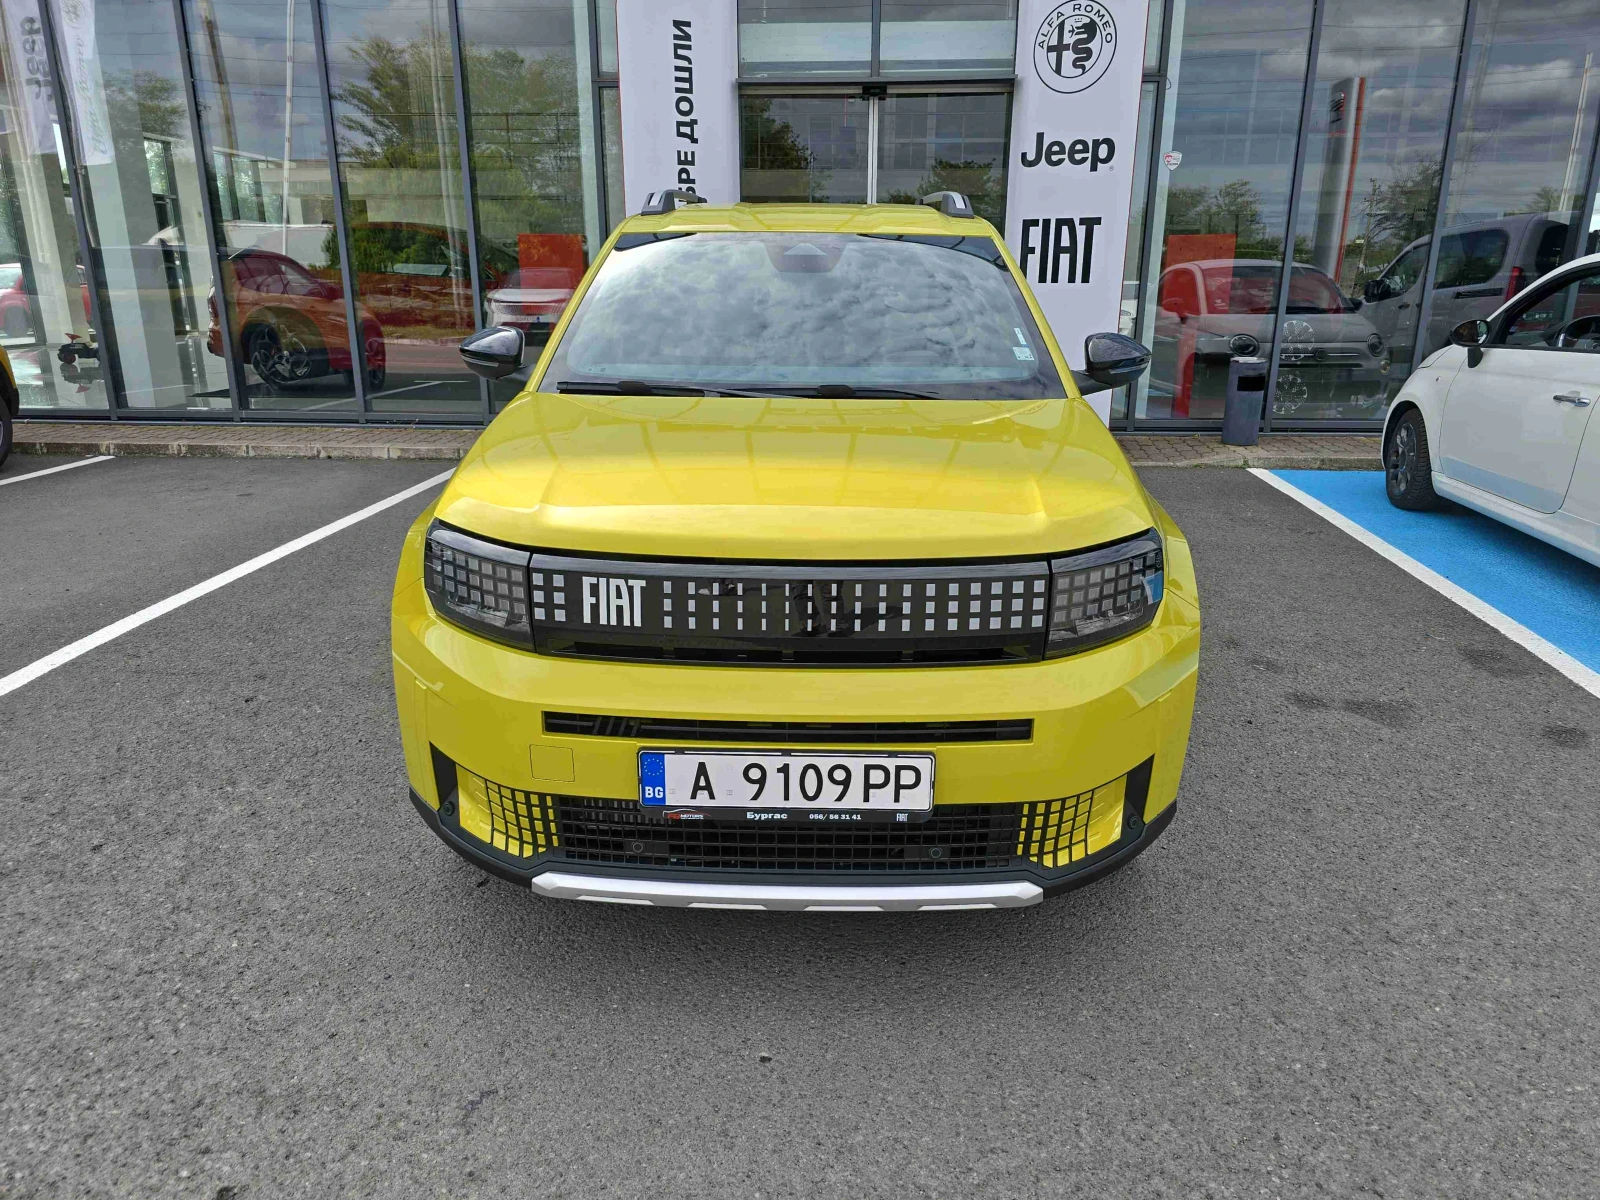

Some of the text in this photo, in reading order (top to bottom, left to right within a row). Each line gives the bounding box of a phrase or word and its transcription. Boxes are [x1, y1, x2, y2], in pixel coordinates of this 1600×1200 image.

[1037, 3, 1113, 50] ALFA ROMEO
[672, 19, 699, 144] ДОШЛИ
[1020, 132, 1116, 172] Jeep
[1020, 217, 1102, 283] FIAT
[582, 576, 646, 627] FIAT
[644, 786, 664, 799] BG
[690, 761, 716, 800] A
[746, 811, 788, 820] Бургас
[896, 813, 909, 822] FIAT
